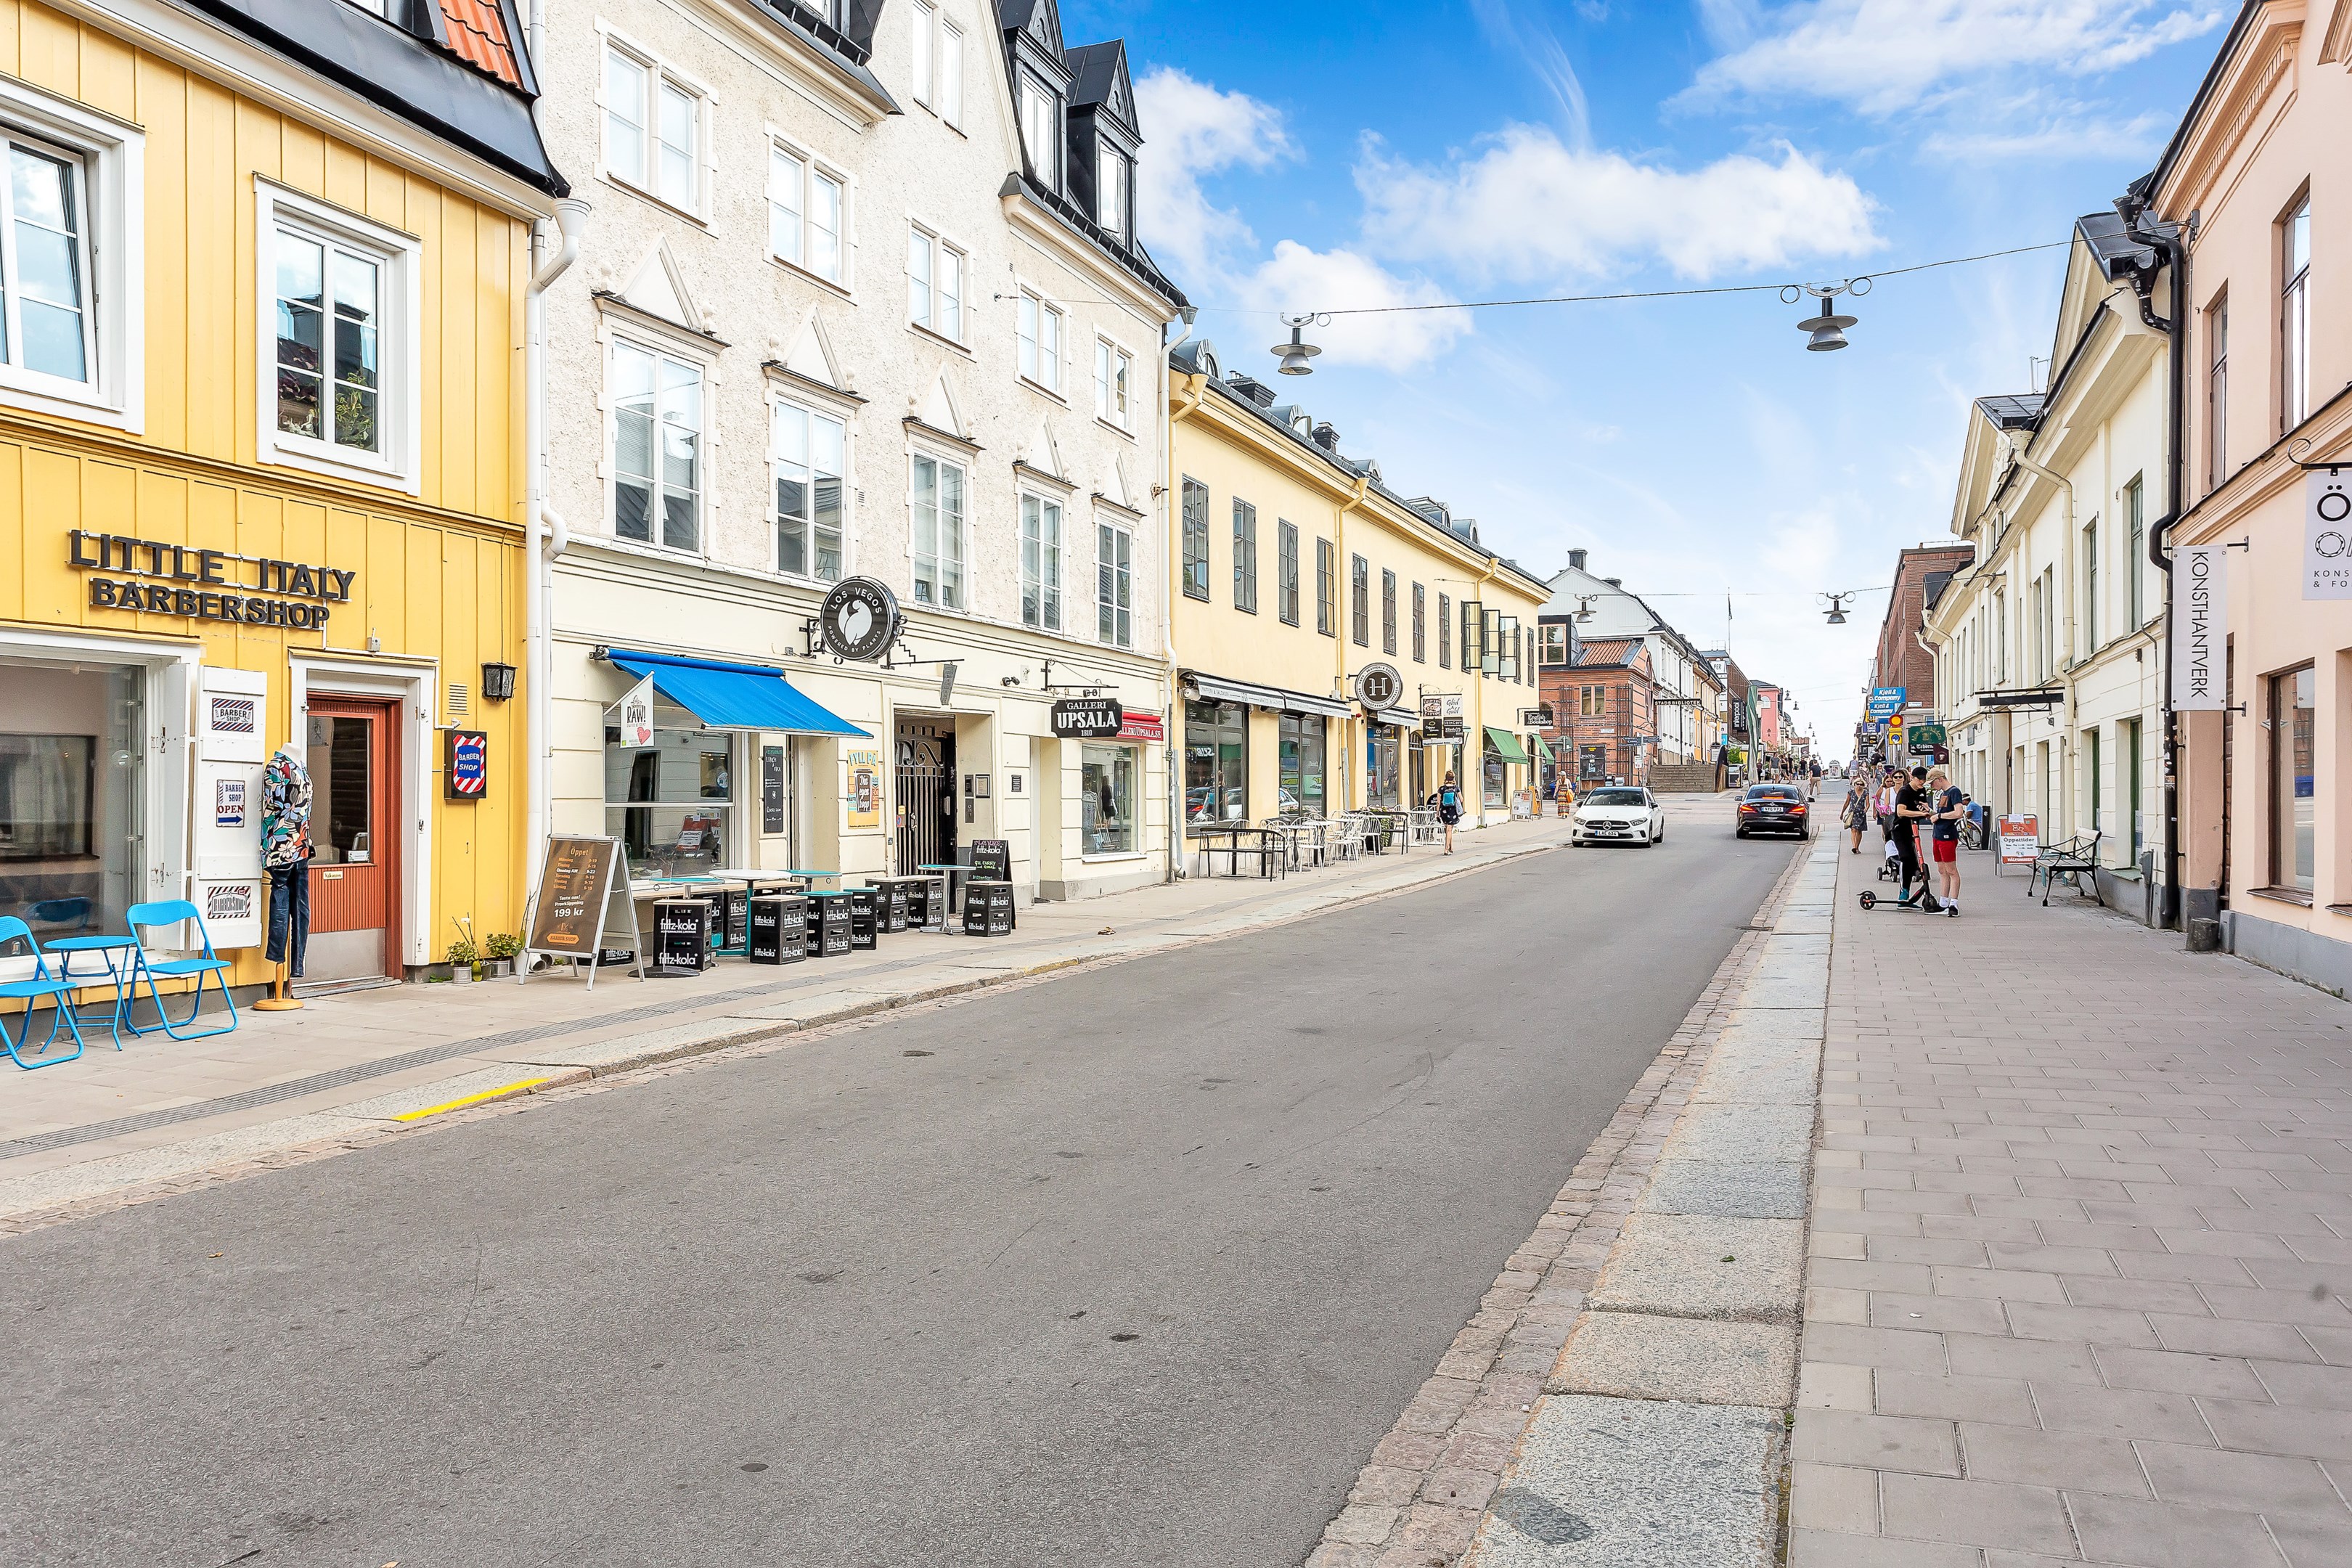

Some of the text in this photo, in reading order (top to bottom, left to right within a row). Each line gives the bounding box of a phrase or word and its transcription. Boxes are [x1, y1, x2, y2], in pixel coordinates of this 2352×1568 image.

[70, 529, 356, 600] LITTLE ITALY
[93, 578, 330, 629] BARBERSHOP
[830, 587, 882, 613] LOS VEGOS
[2192, 552, 2209, 698] KONSTHANTVERK
[828, 625, 848, 651] POWERED
[862, 630, 881, 650] PLANTS
[1369, 677, 1388, 695] H
[1066, 701, 1106, 710] GALLERI
[220, 709, 248, 719] BARBER
[626, 705, 646, 724] RAW!
[1057, 711, 1118, 728] UPSALA
[458, 753, 480, 761] BARBER
[849, 751, 876, 767] FYLL PÅ
[218, 805, 244, 814] OPEN
[571, 846, 589, 857] Öppet
[976, 845, 1001, 854] fritz-kola
[891, 892, 907, 902] fritz-kola
[990, 897, 1009, 907] fritz-kola
[213, 897, 245, 912] BARBERSHOP
[730, 902, 747, 913] fritz-kol
[554, 907, 584, 918] 199 kr
[826, 909, 849, 921] fritz-kola
[660, 918, 698, 931] fritz-kola
[754, 916, 775, 925] fritz-kola
[784, 912, 805, 926] fritz-kola
[990, 922, 1009, 932] fritz-kola
[730, 932, 746, 944] fritz-ko
[826, 937, 849, 950] fritz-kola
[754, 947, 775, 957] fritz-kola
[783, 945, 804, 958] fritz-kola
[658, 952, 698, 965] fritz-kola
